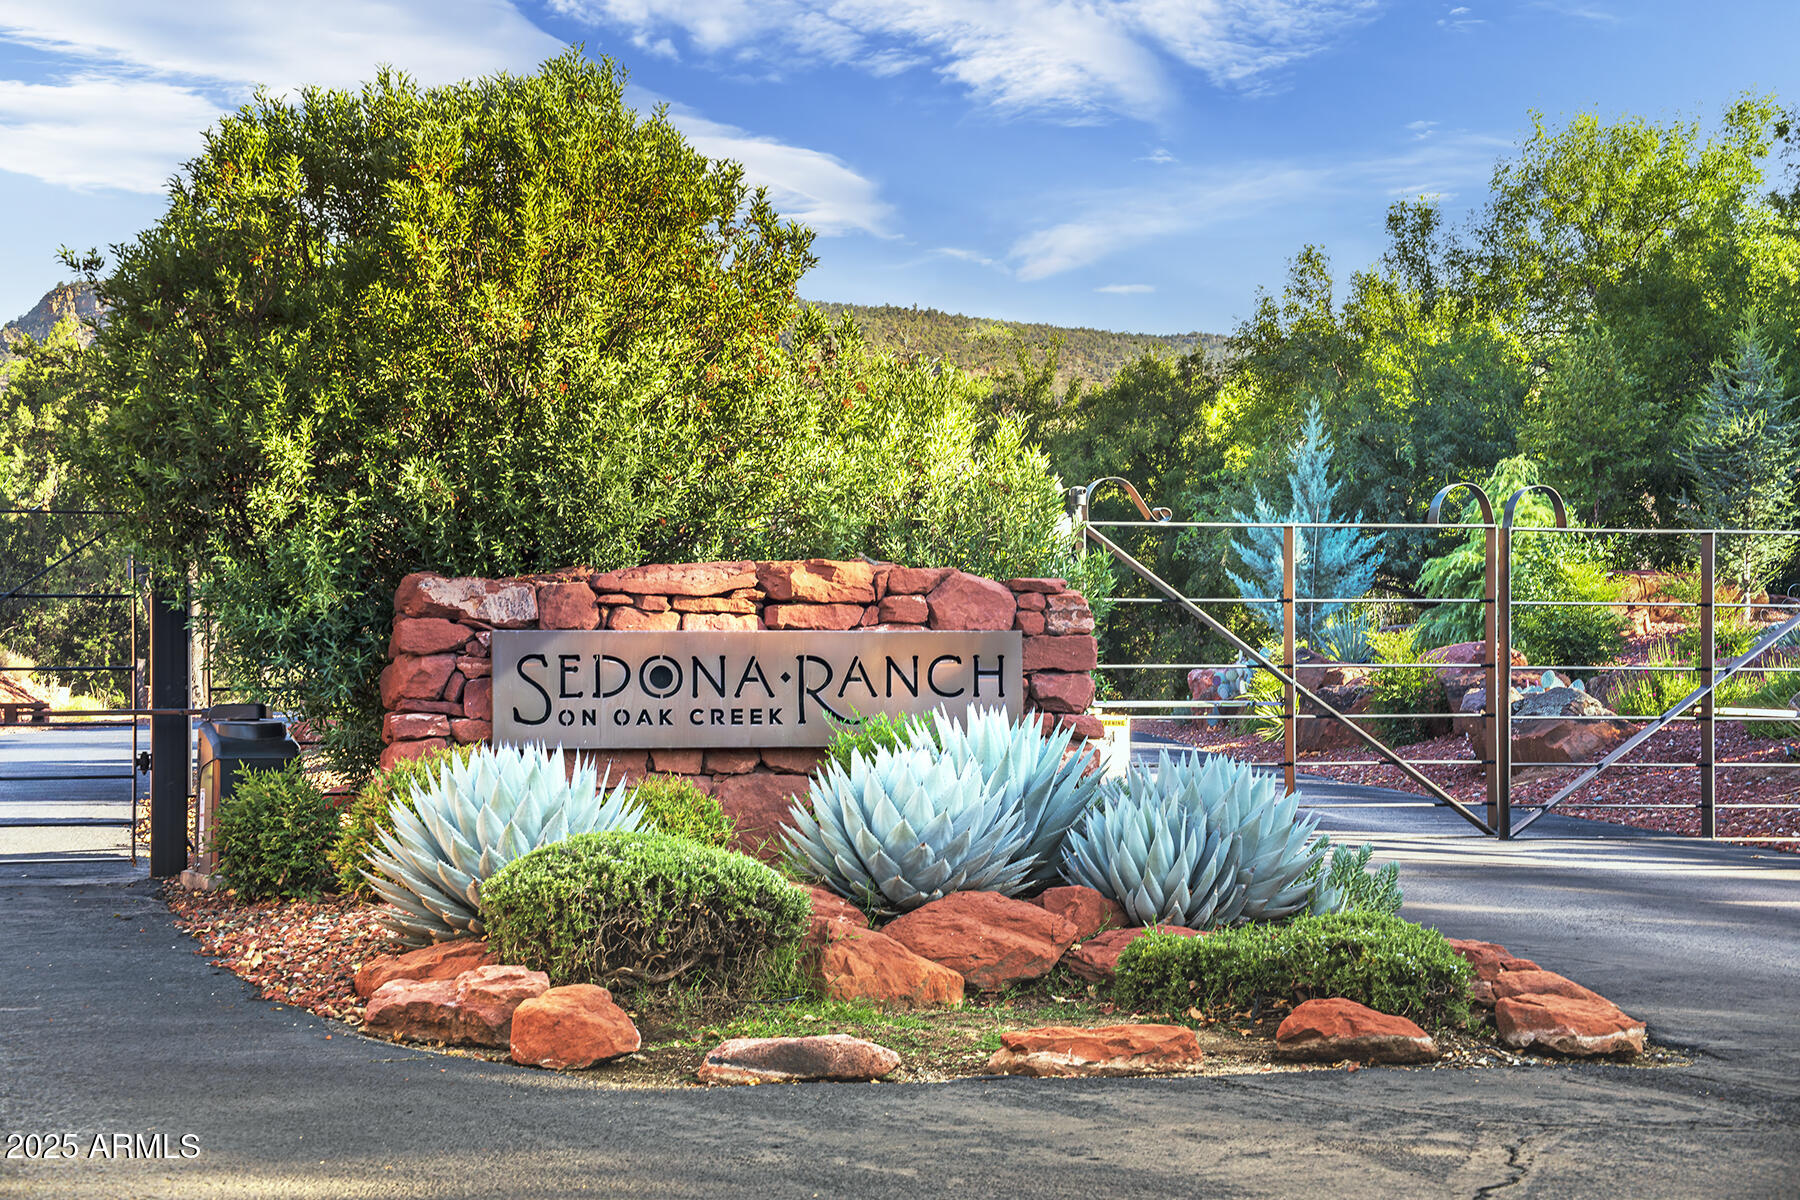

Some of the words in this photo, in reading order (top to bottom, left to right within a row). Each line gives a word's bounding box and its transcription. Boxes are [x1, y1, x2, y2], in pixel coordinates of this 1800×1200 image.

[513, 653, 776, 726] SEDONA
[796, 653, 1005, 726] RANCH
[557, 708, 597, 727] ON
[613, 708, 674, 727] OAK
[689, 708, 784, 727] CREEK
